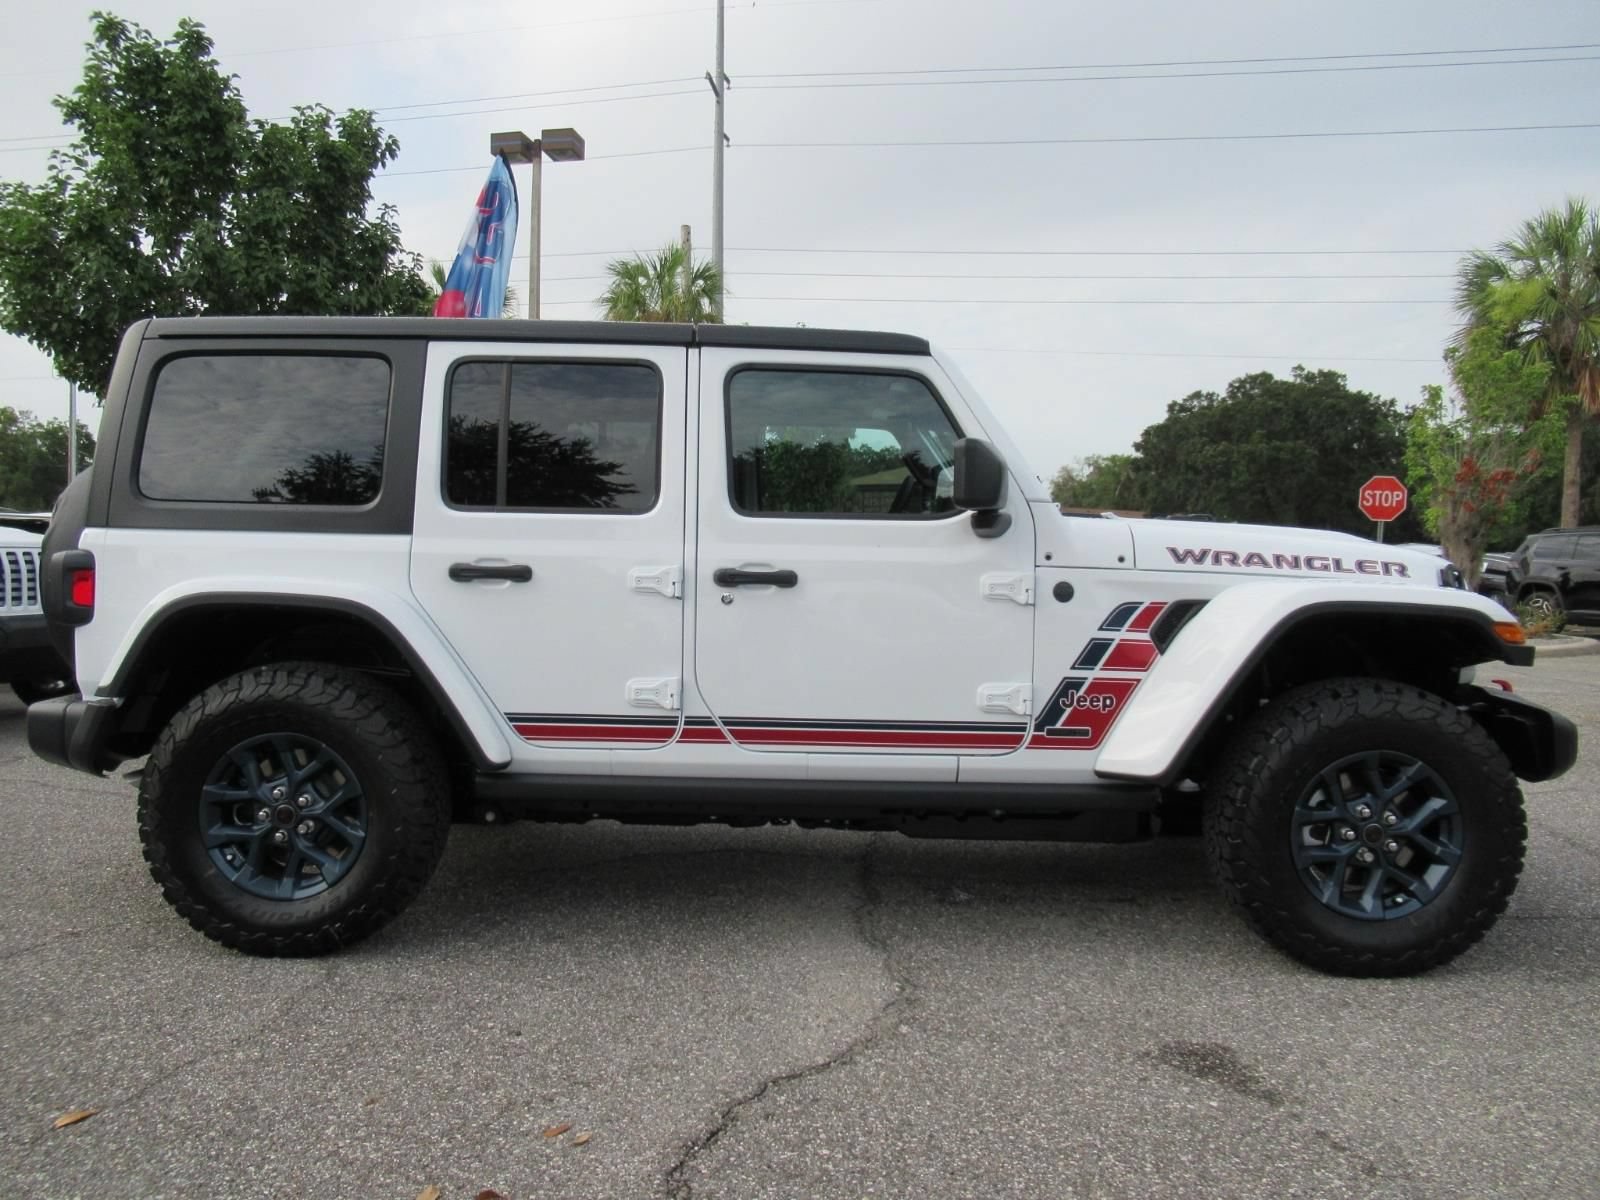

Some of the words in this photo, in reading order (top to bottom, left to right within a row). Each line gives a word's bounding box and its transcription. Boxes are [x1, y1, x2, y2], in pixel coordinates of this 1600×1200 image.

[1362, 490, 1403, 507] STOP
[1166, 547, 1412, 578] WRANGLER
[1059, 690, 1116, 713] Jeep
